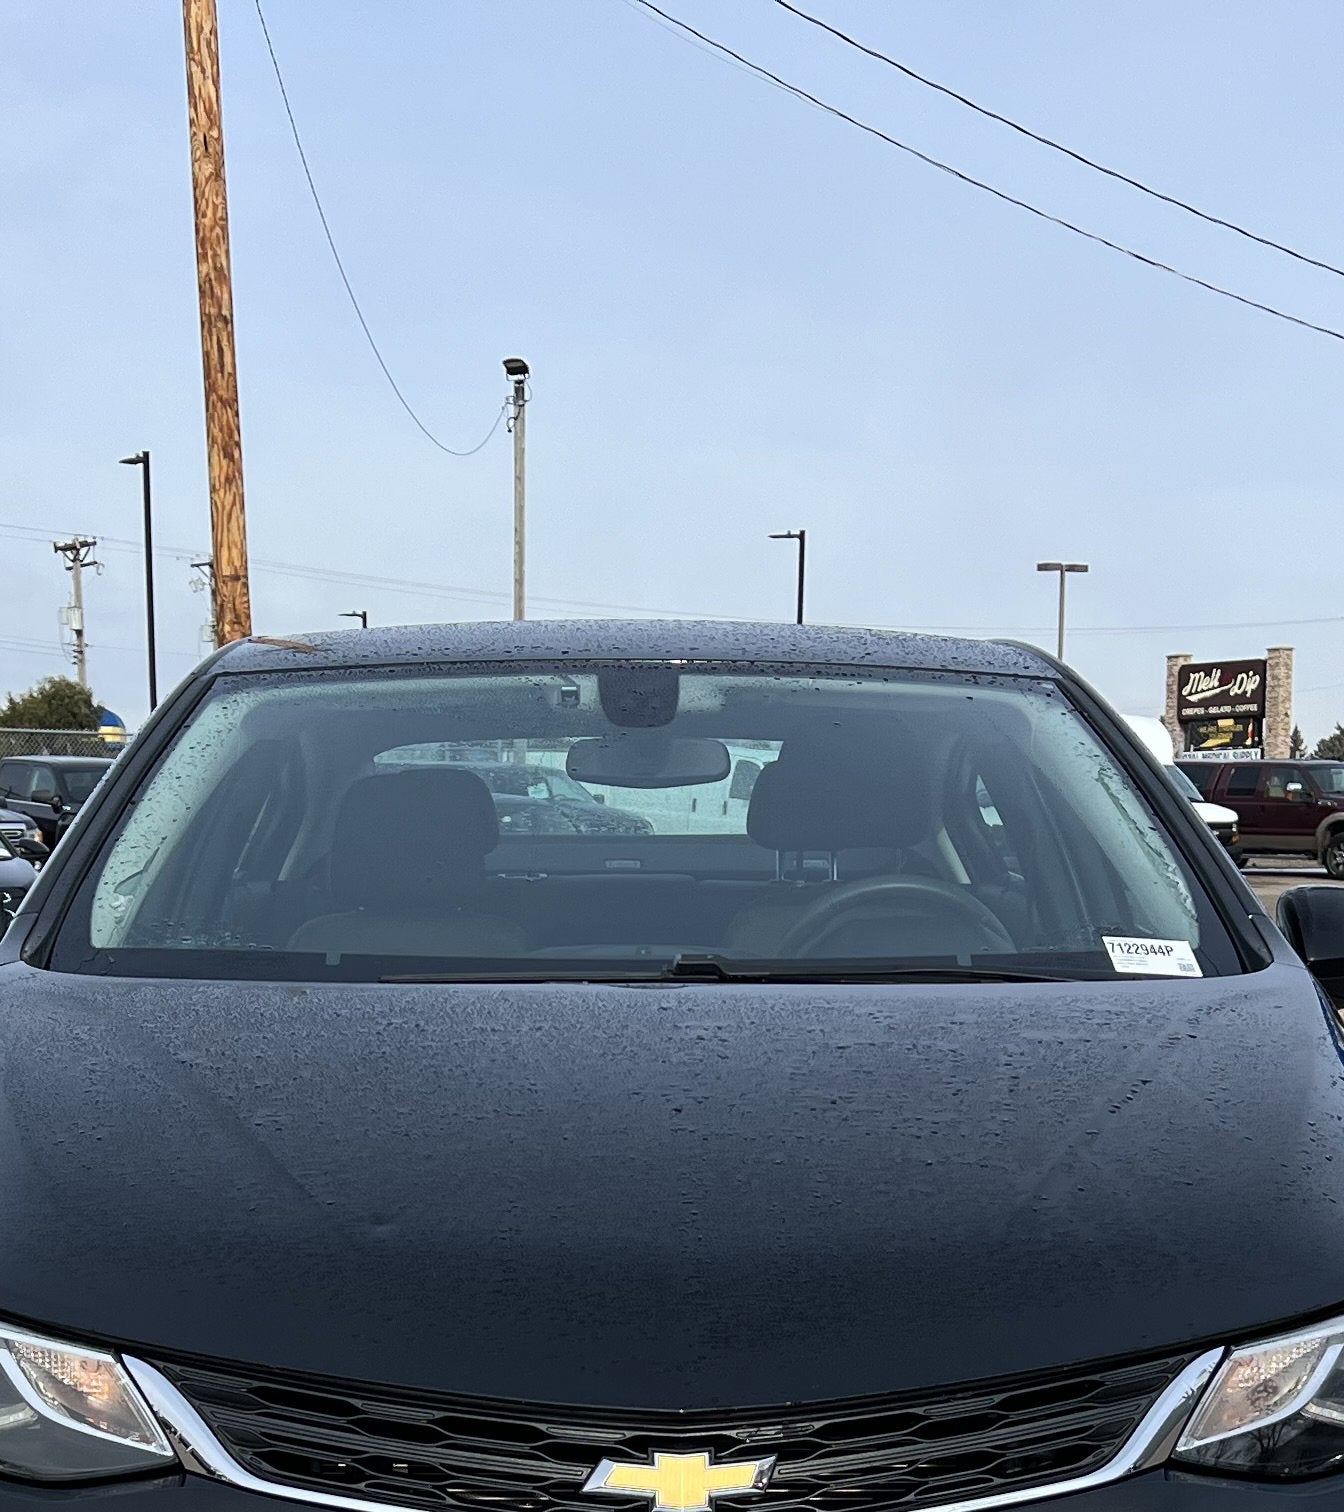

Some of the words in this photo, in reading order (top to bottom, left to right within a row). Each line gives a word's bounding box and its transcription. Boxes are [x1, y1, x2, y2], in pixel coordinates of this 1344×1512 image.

[1181, 668, 1221, 696] Melt
[1229, 670, 1260, 698] Dip
[1107, 942, 1174, 957] 7122944P
